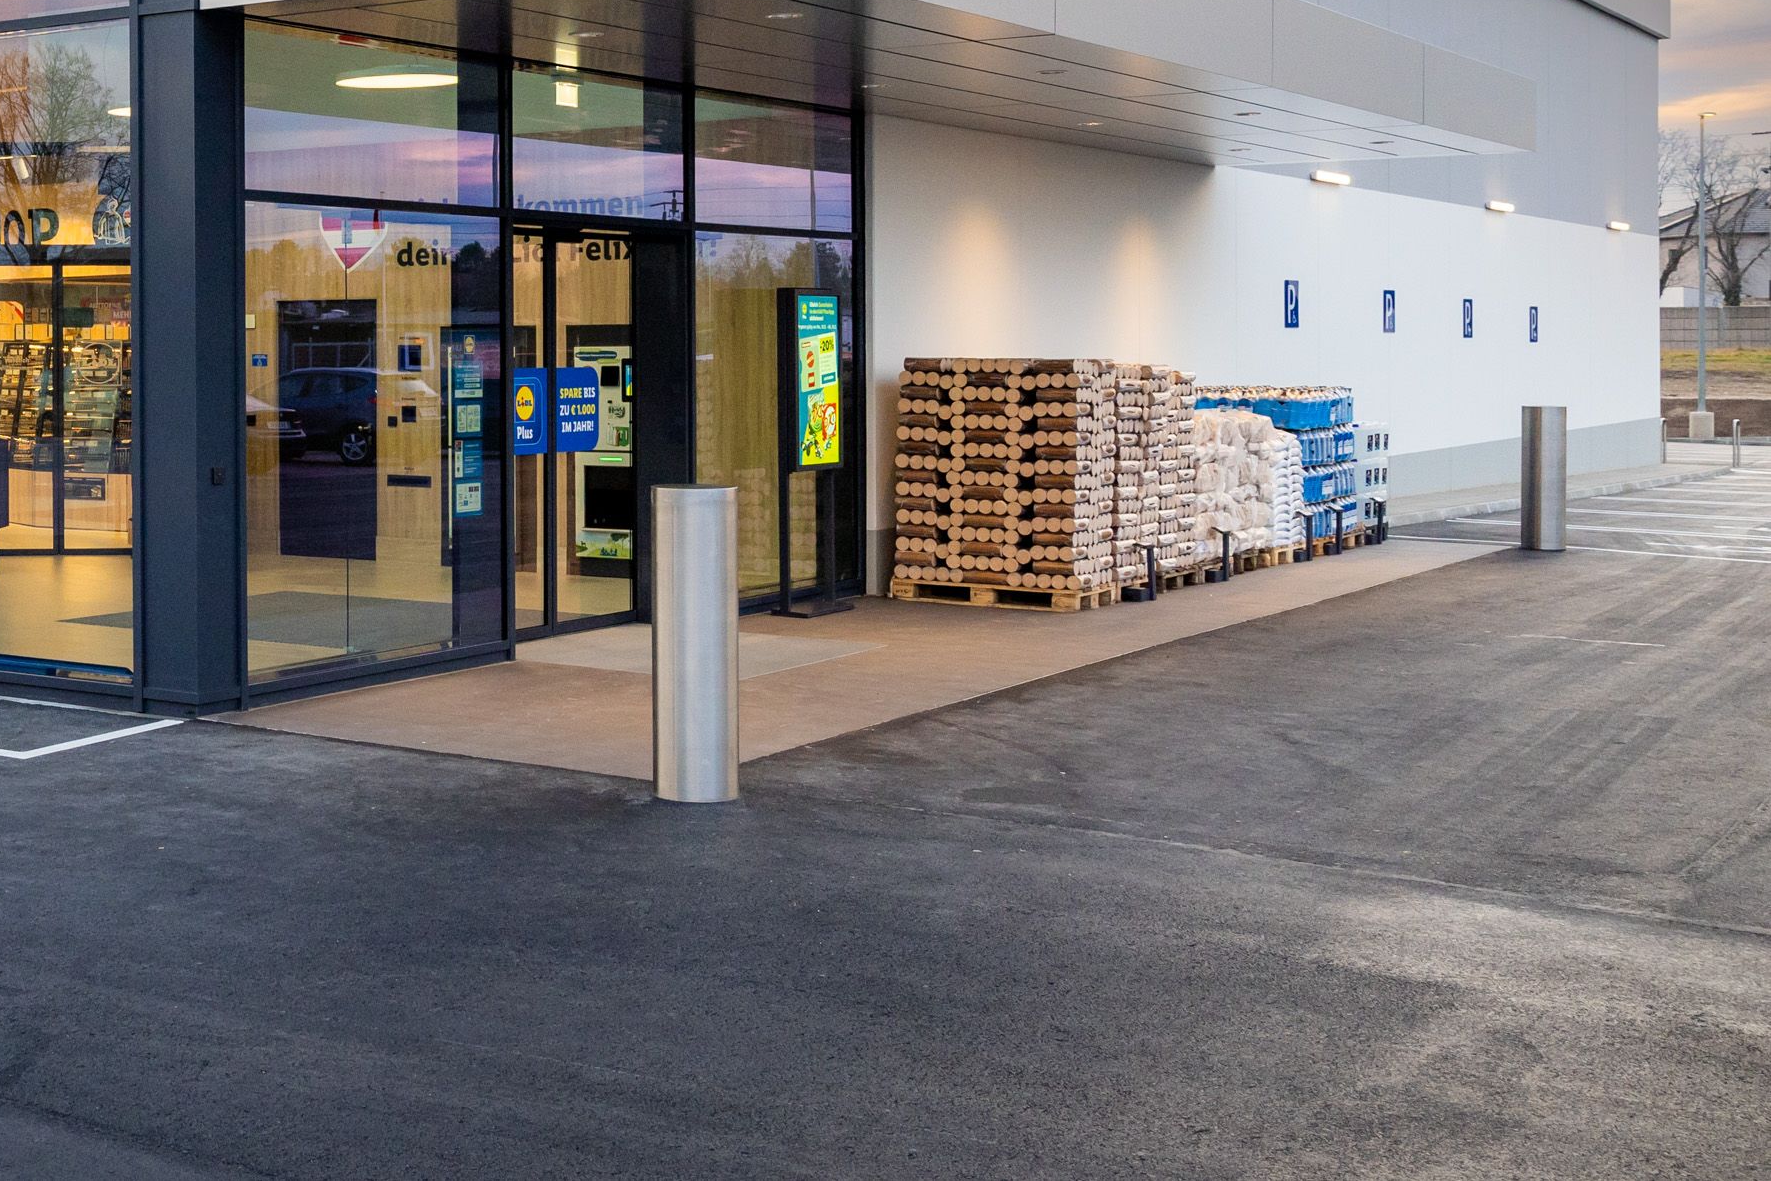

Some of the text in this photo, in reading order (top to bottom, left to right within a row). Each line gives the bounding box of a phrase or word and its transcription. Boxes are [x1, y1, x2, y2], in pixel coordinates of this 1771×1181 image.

[1288, 284, 1296, 323] P
[1386, 294, 1393, 329] P
[1465, 301, 1471, 335] P
[820, 339, 834, 351] -20%
[560, 387, 596, 399] SPARE BIS
[560, 405, 569, 416] ZU
[571, 405, 576, 415] €
[577, 404, 596, 415] 1.000
[517, 426, 533, 439] Plus
[562, 421, 594, 432] IM JAHR!
